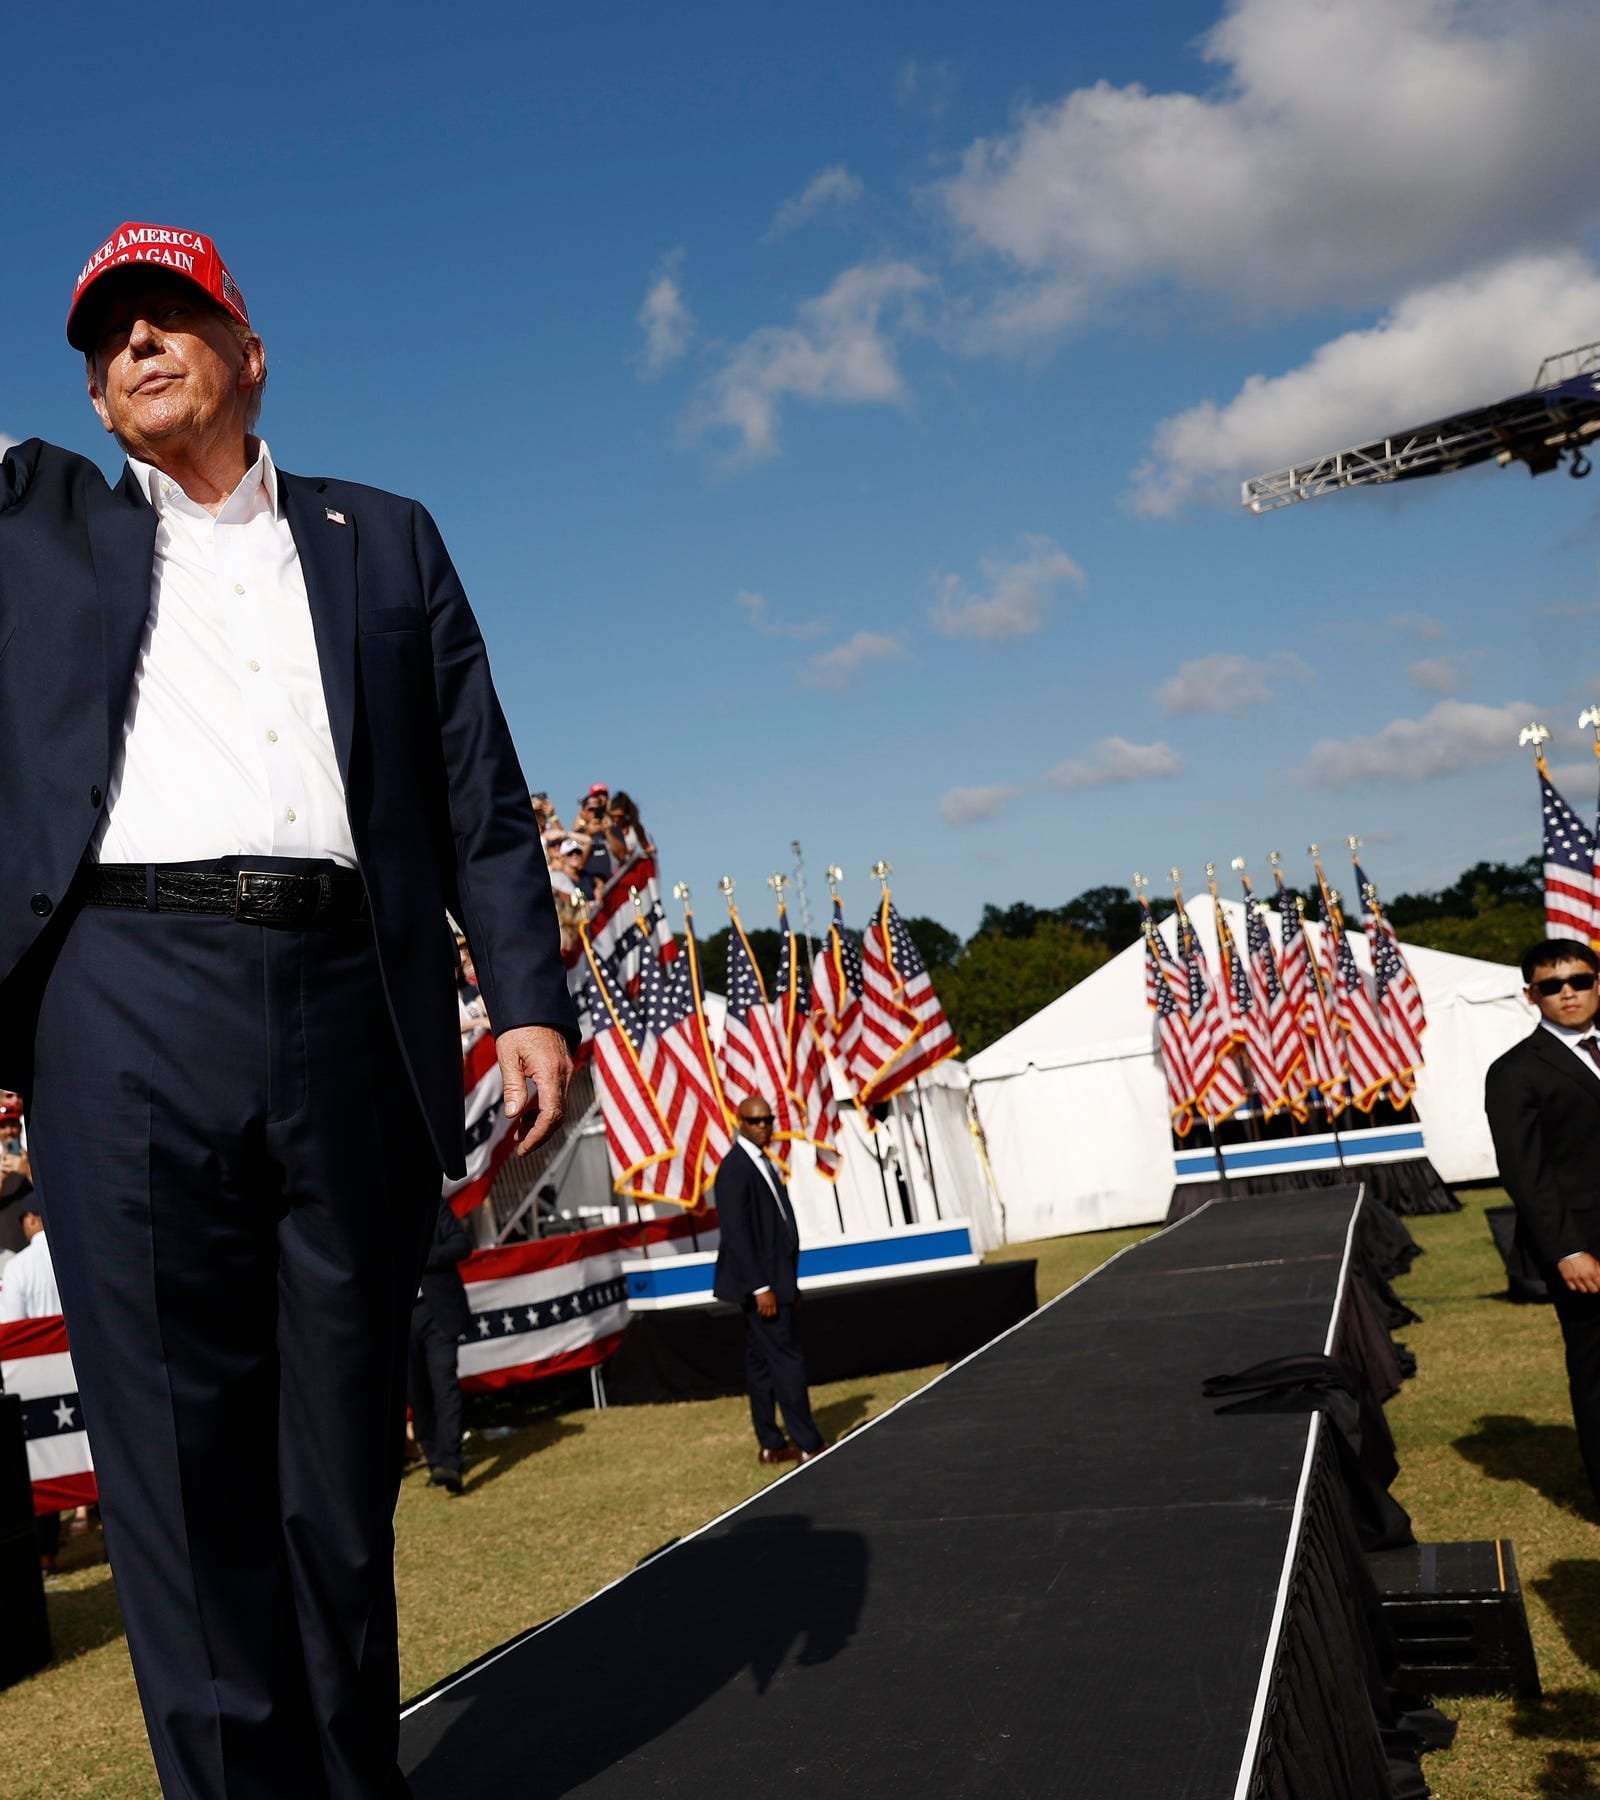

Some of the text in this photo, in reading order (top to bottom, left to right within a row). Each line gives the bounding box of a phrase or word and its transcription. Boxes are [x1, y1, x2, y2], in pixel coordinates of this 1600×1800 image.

[76, 240, 114, 291] MAKE
[115, 228, 205, 254] AMERICA
[136, 248, 194, 274] AGAIN
